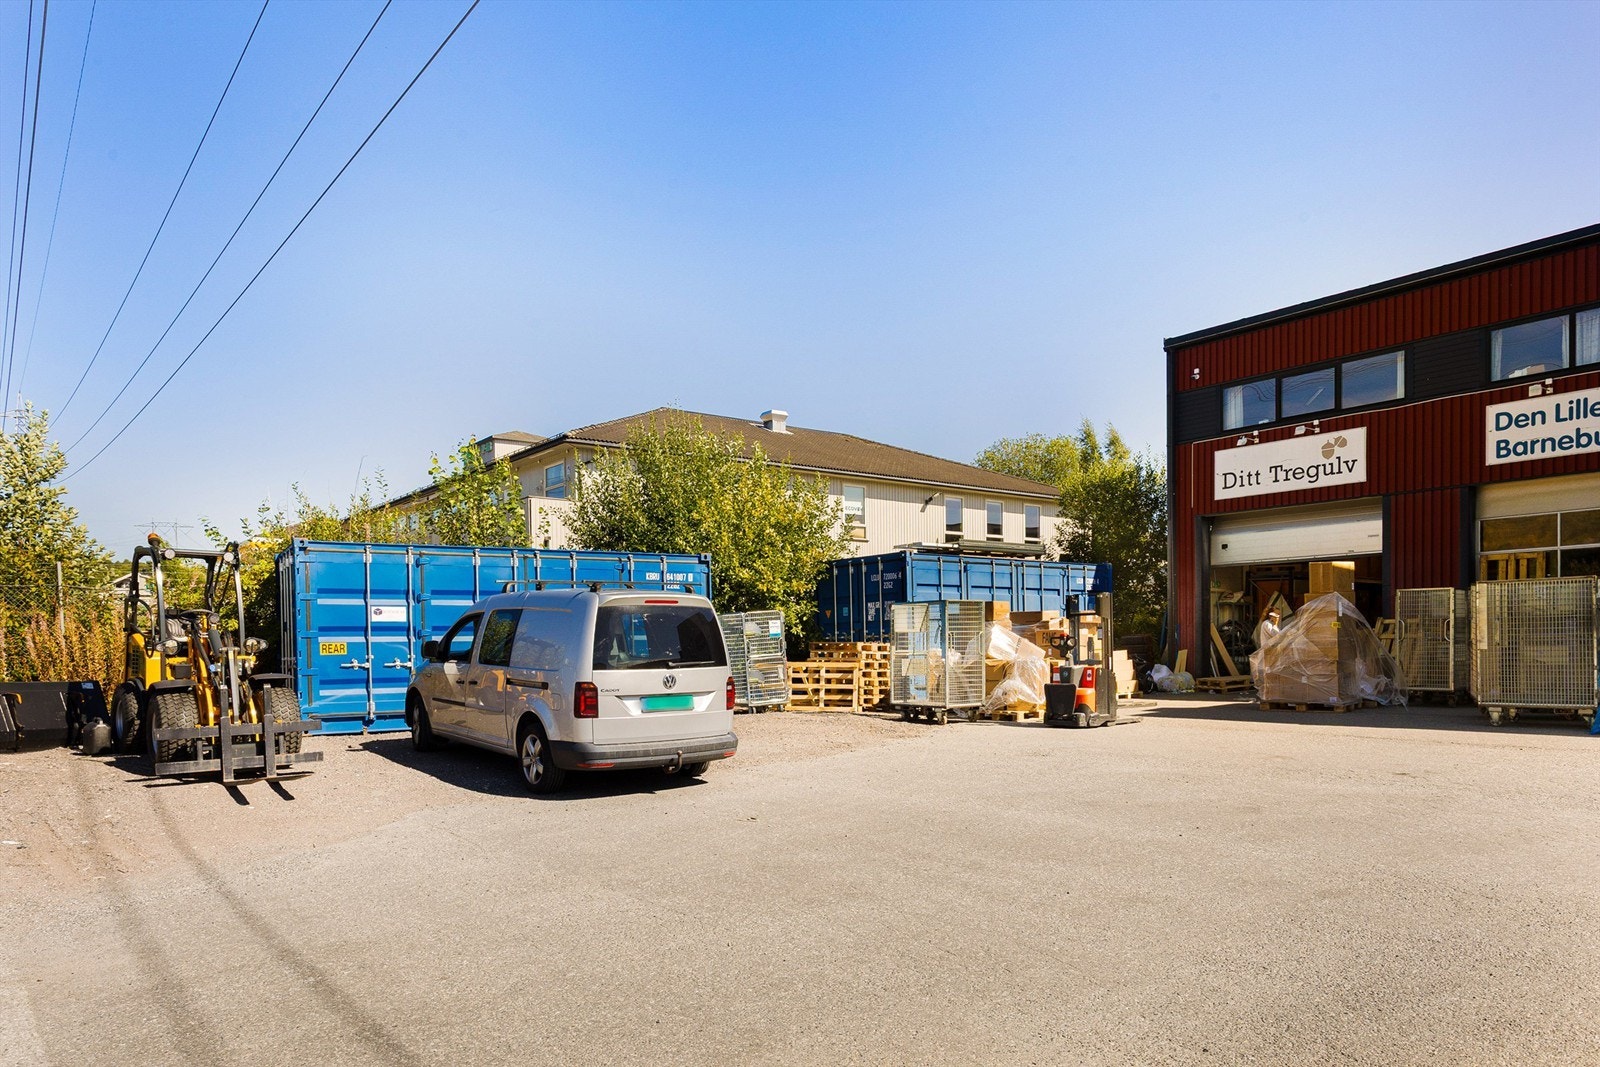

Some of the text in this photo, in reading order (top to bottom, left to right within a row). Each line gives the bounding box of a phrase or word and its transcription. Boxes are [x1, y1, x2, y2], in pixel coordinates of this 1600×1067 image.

[1495, 397, 1600, 432] Den Lille
[1222, 456, 1358, 490] Ditt Tregulv
[321, 643, 346, 654] REAR
